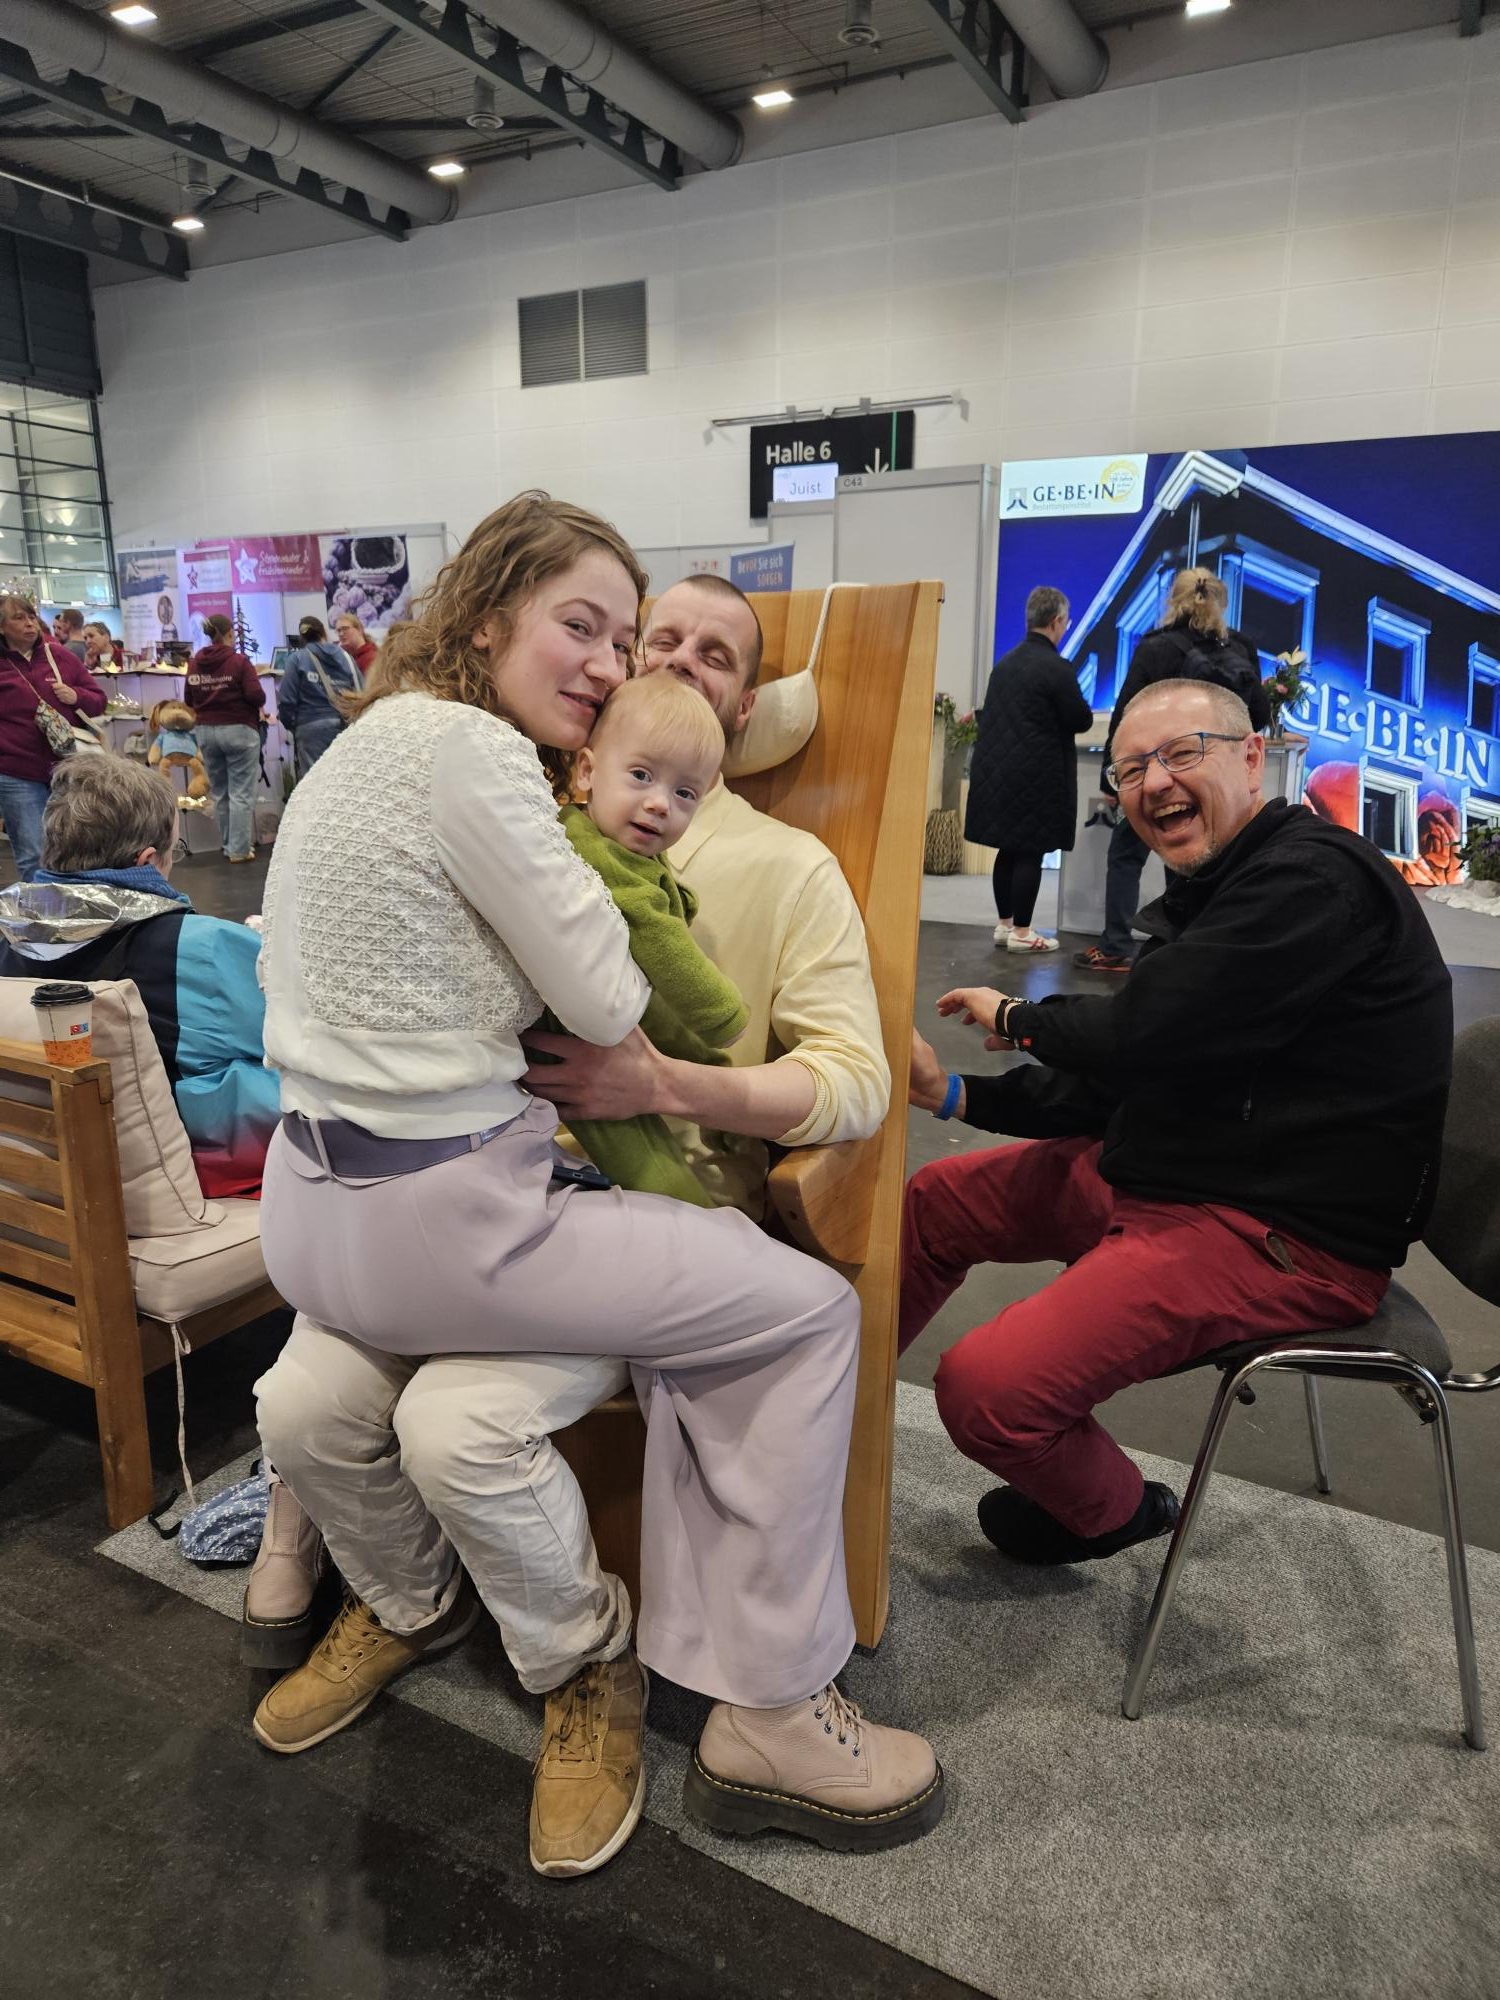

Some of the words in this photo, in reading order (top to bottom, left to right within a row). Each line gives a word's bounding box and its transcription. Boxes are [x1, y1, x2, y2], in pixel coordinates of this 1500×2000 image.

[766, 441, 815, 465] Halle
[820, 441, 831, 460] 6
[790, 482, 822, 495] Juist
[844, 478, 863, 487] C42
